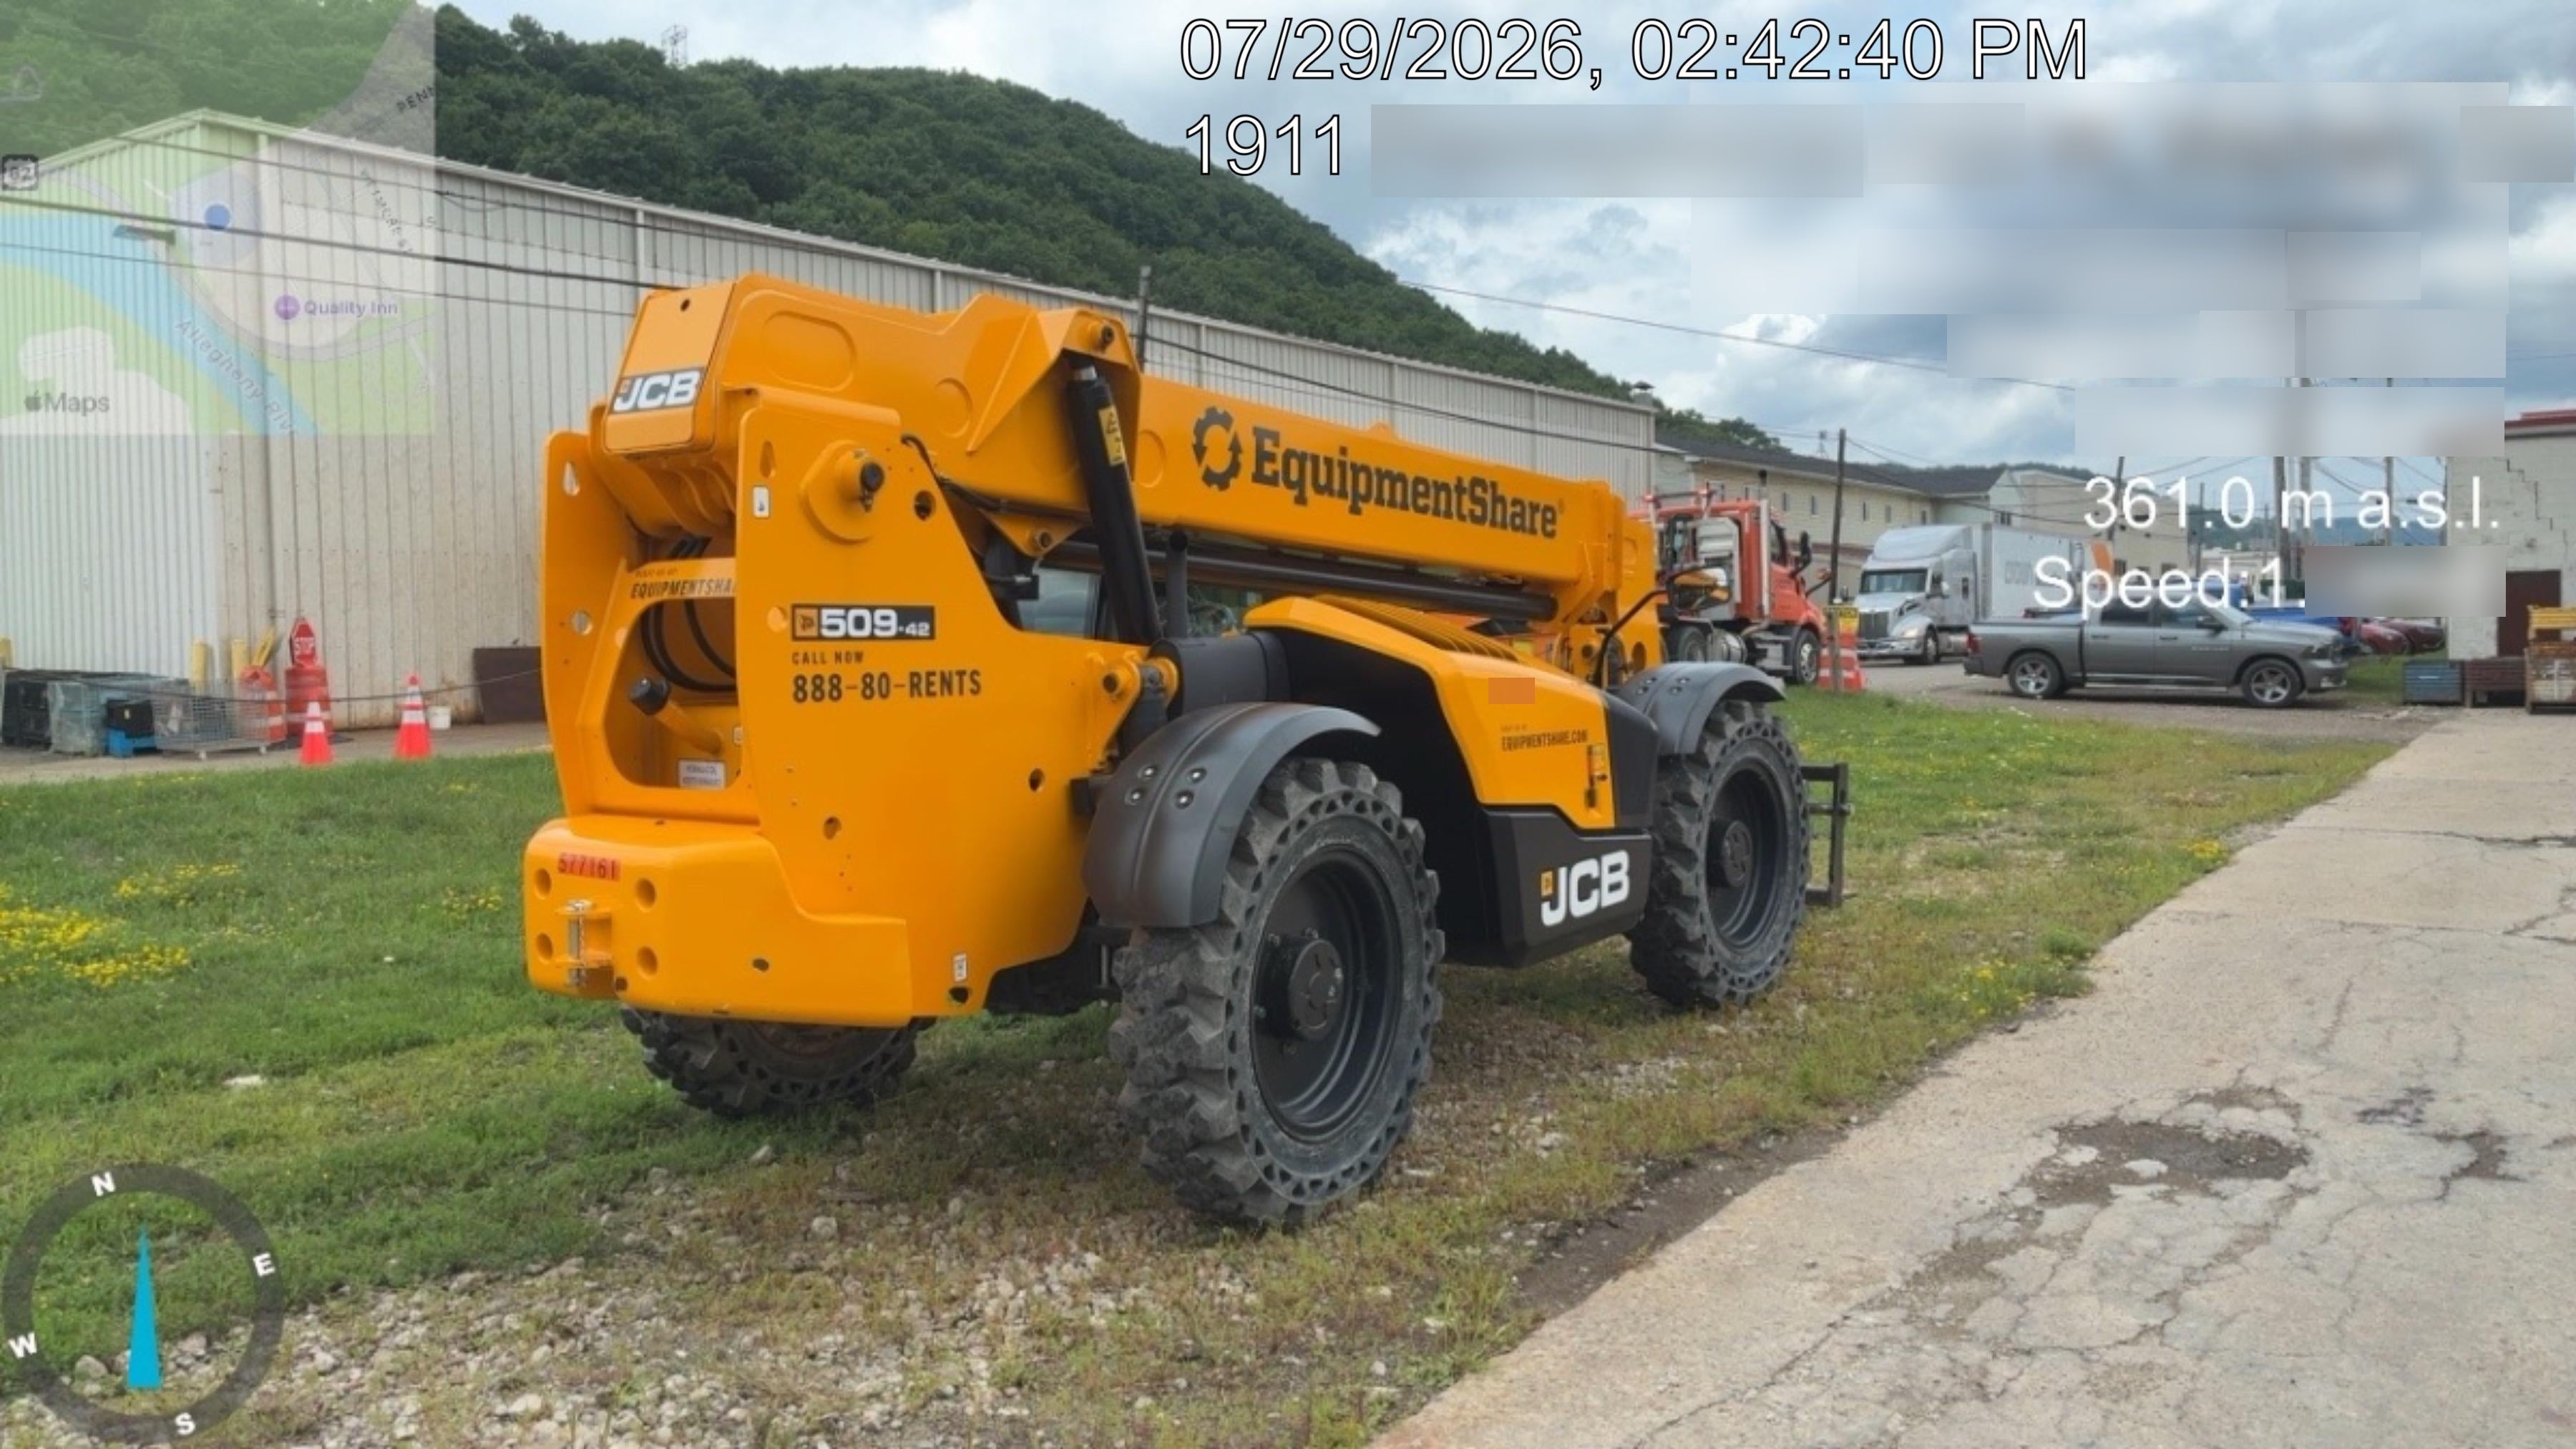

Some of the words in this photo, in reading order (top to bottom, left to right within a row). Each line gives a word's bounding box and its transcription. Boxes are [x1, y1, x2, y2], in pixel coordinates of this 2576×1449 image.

[613, 370, 701, 412] JCB
[1252, 426, 1557, 539] EquipmentShare
[630, 577, 736, 599] EQUIPMENTSHA
[792, 651, 826, 665] CALL
[834, 650, 864, 664] NOW
[793, 669, 982, 703] 888-80-RENTS
[1541, 849, 1630, 927] JCB
